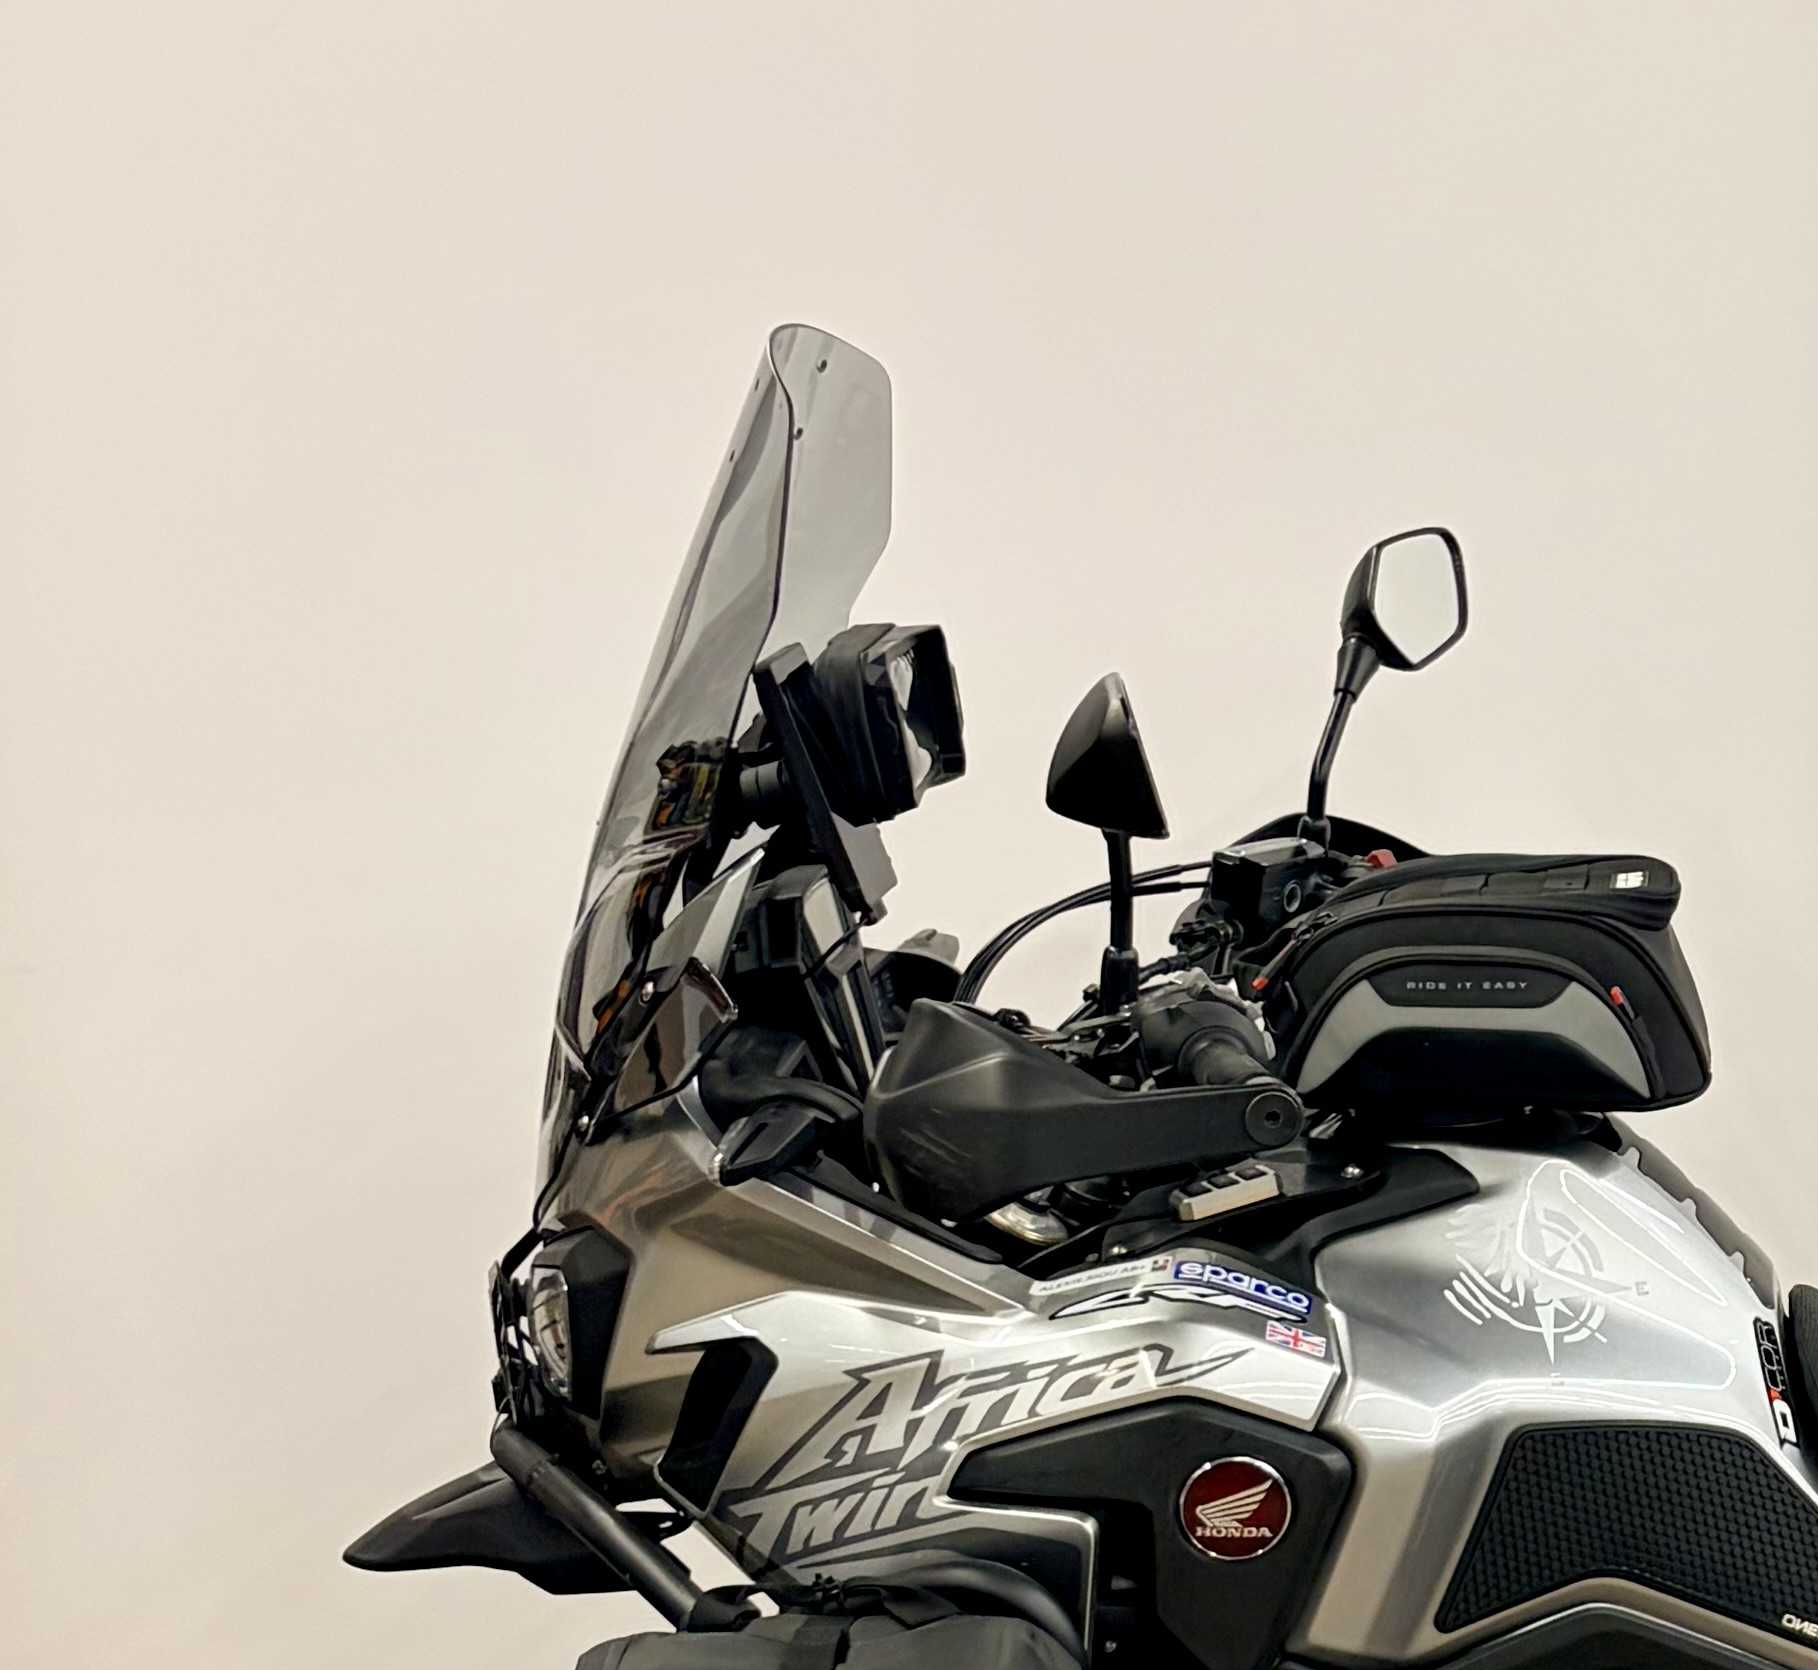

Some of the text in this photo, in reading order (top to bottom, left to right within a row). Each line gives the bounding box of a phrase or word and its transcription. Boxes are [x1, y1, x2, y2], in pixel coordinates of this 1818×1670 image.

[1405, 980, 1528, 991] RIDE IT EASY
[1178, 1261, 1310, 1313] sparco
[753, 1343, 1255, 1489] Africa
[724, 1467, 952, 1567] Twin
[1195, 1526, 1274, 1538] HONDA
